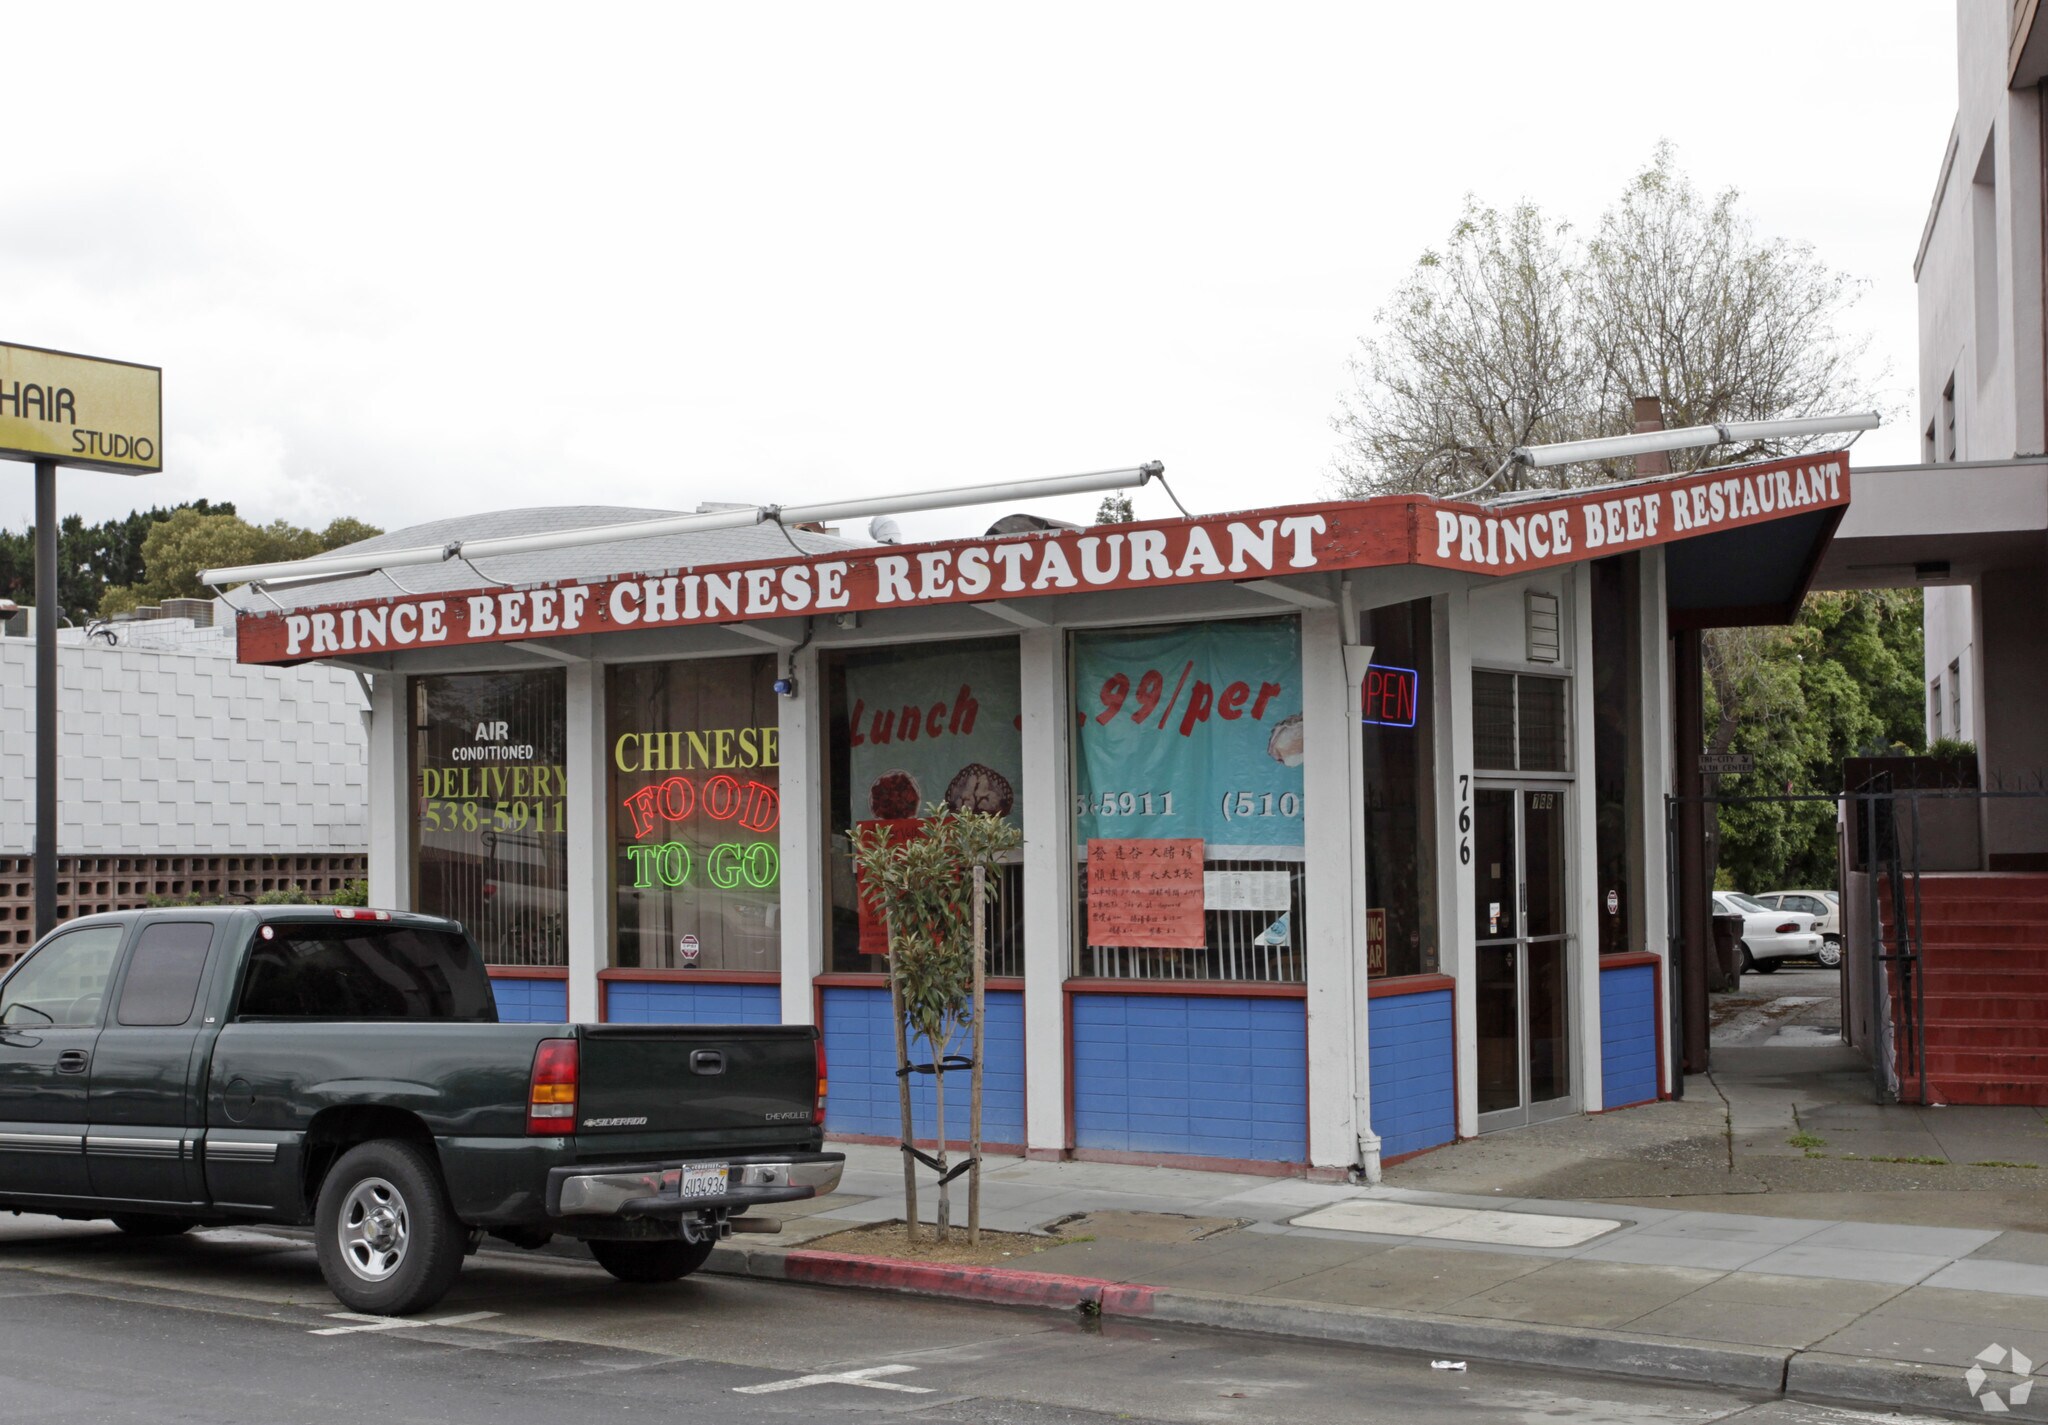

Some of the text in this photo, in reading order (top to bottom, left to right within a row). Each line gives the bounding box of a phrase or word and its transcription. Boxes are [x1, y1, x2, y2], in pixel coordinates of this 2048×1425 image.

[0, 379, 76, 425] HAIR
[72, 429, 154, 461] STUDIO
[1436, 462, 1841, 565] PRINCE BEEF RESTAURANT
[286, 514, 1327, 655] PRINCE BEEF CHINESE RESTAURANT
[475, 721, 509, 741] AIR
[850, 683, 979, 748] Lunch
[452, 745, 533, 761] CONDITIONED
[615, 727, 780, 772] CHINESE
[422, 765, 567, 798] DELIVERY
[425, 800, 566, 832] 538-5911
[624, 775, 780, 839] FOOD
[1221, 791, 1304, 822] (510
[1458, 774, 1471, 866] 766
[627, 842, 779, 888] TO GO
[596, 1117, 648, 1127] SILVERADO
[765, 1111, 810, 1121] CHEVROLET
